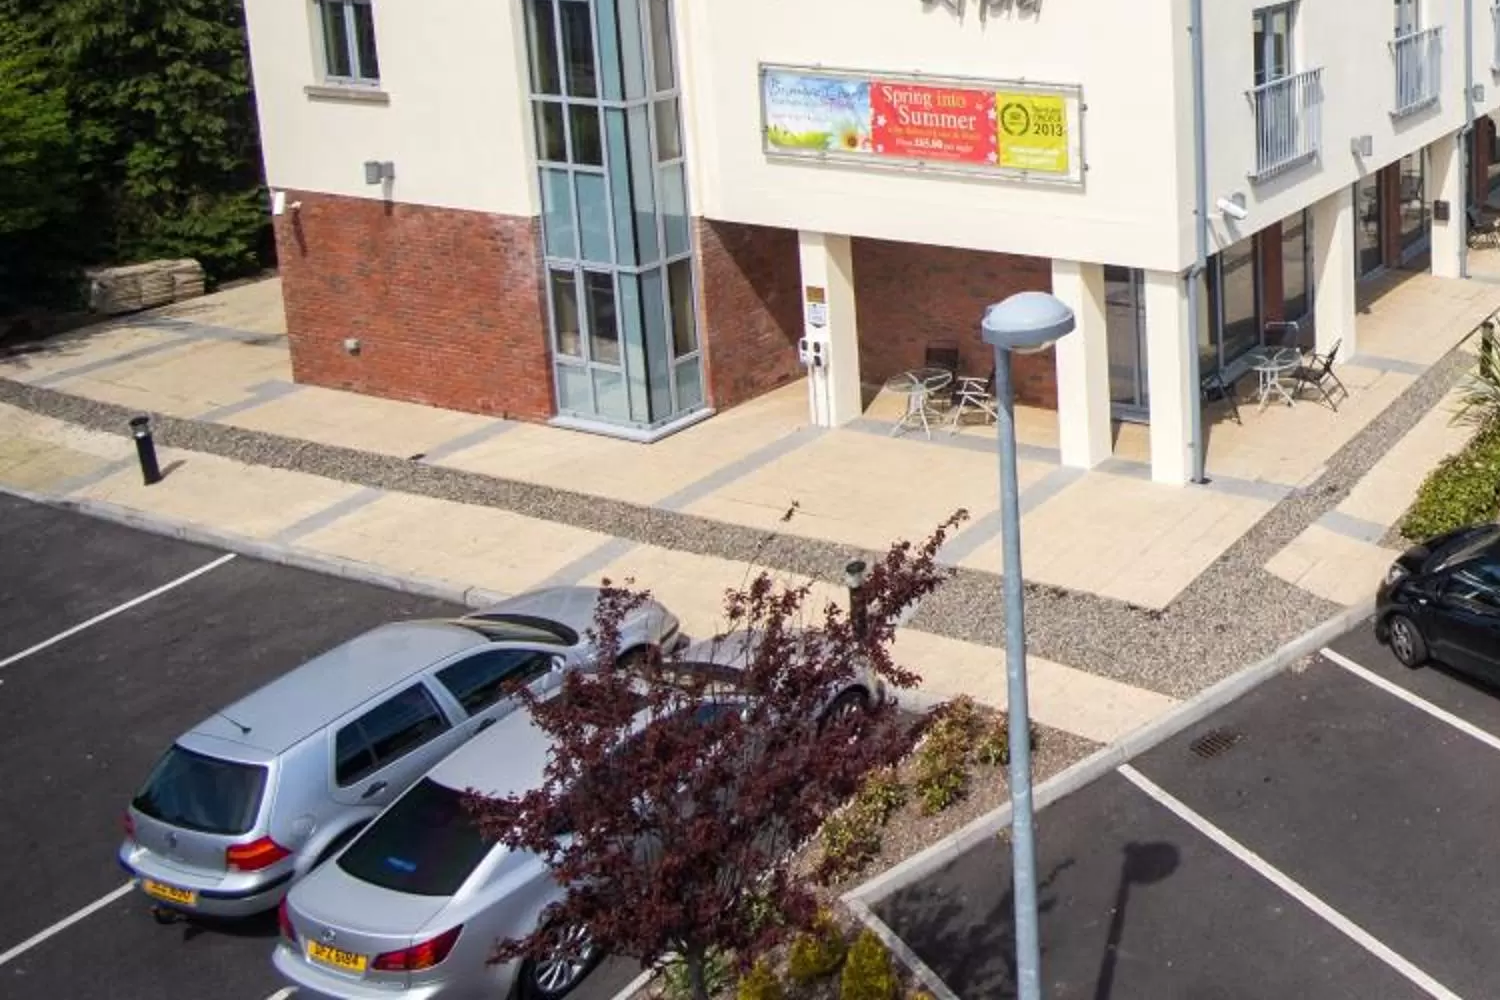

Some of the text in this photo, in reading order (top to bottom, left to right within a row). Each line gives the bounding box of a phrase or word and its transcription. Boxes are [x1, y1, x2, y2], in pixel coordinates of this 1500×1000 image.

[882, 86, 933, 110] Spring
[937, 90, 967, 109] into
[898, 104, 977, 131] Summer
[1033, 123, 1064, 137] 2013
